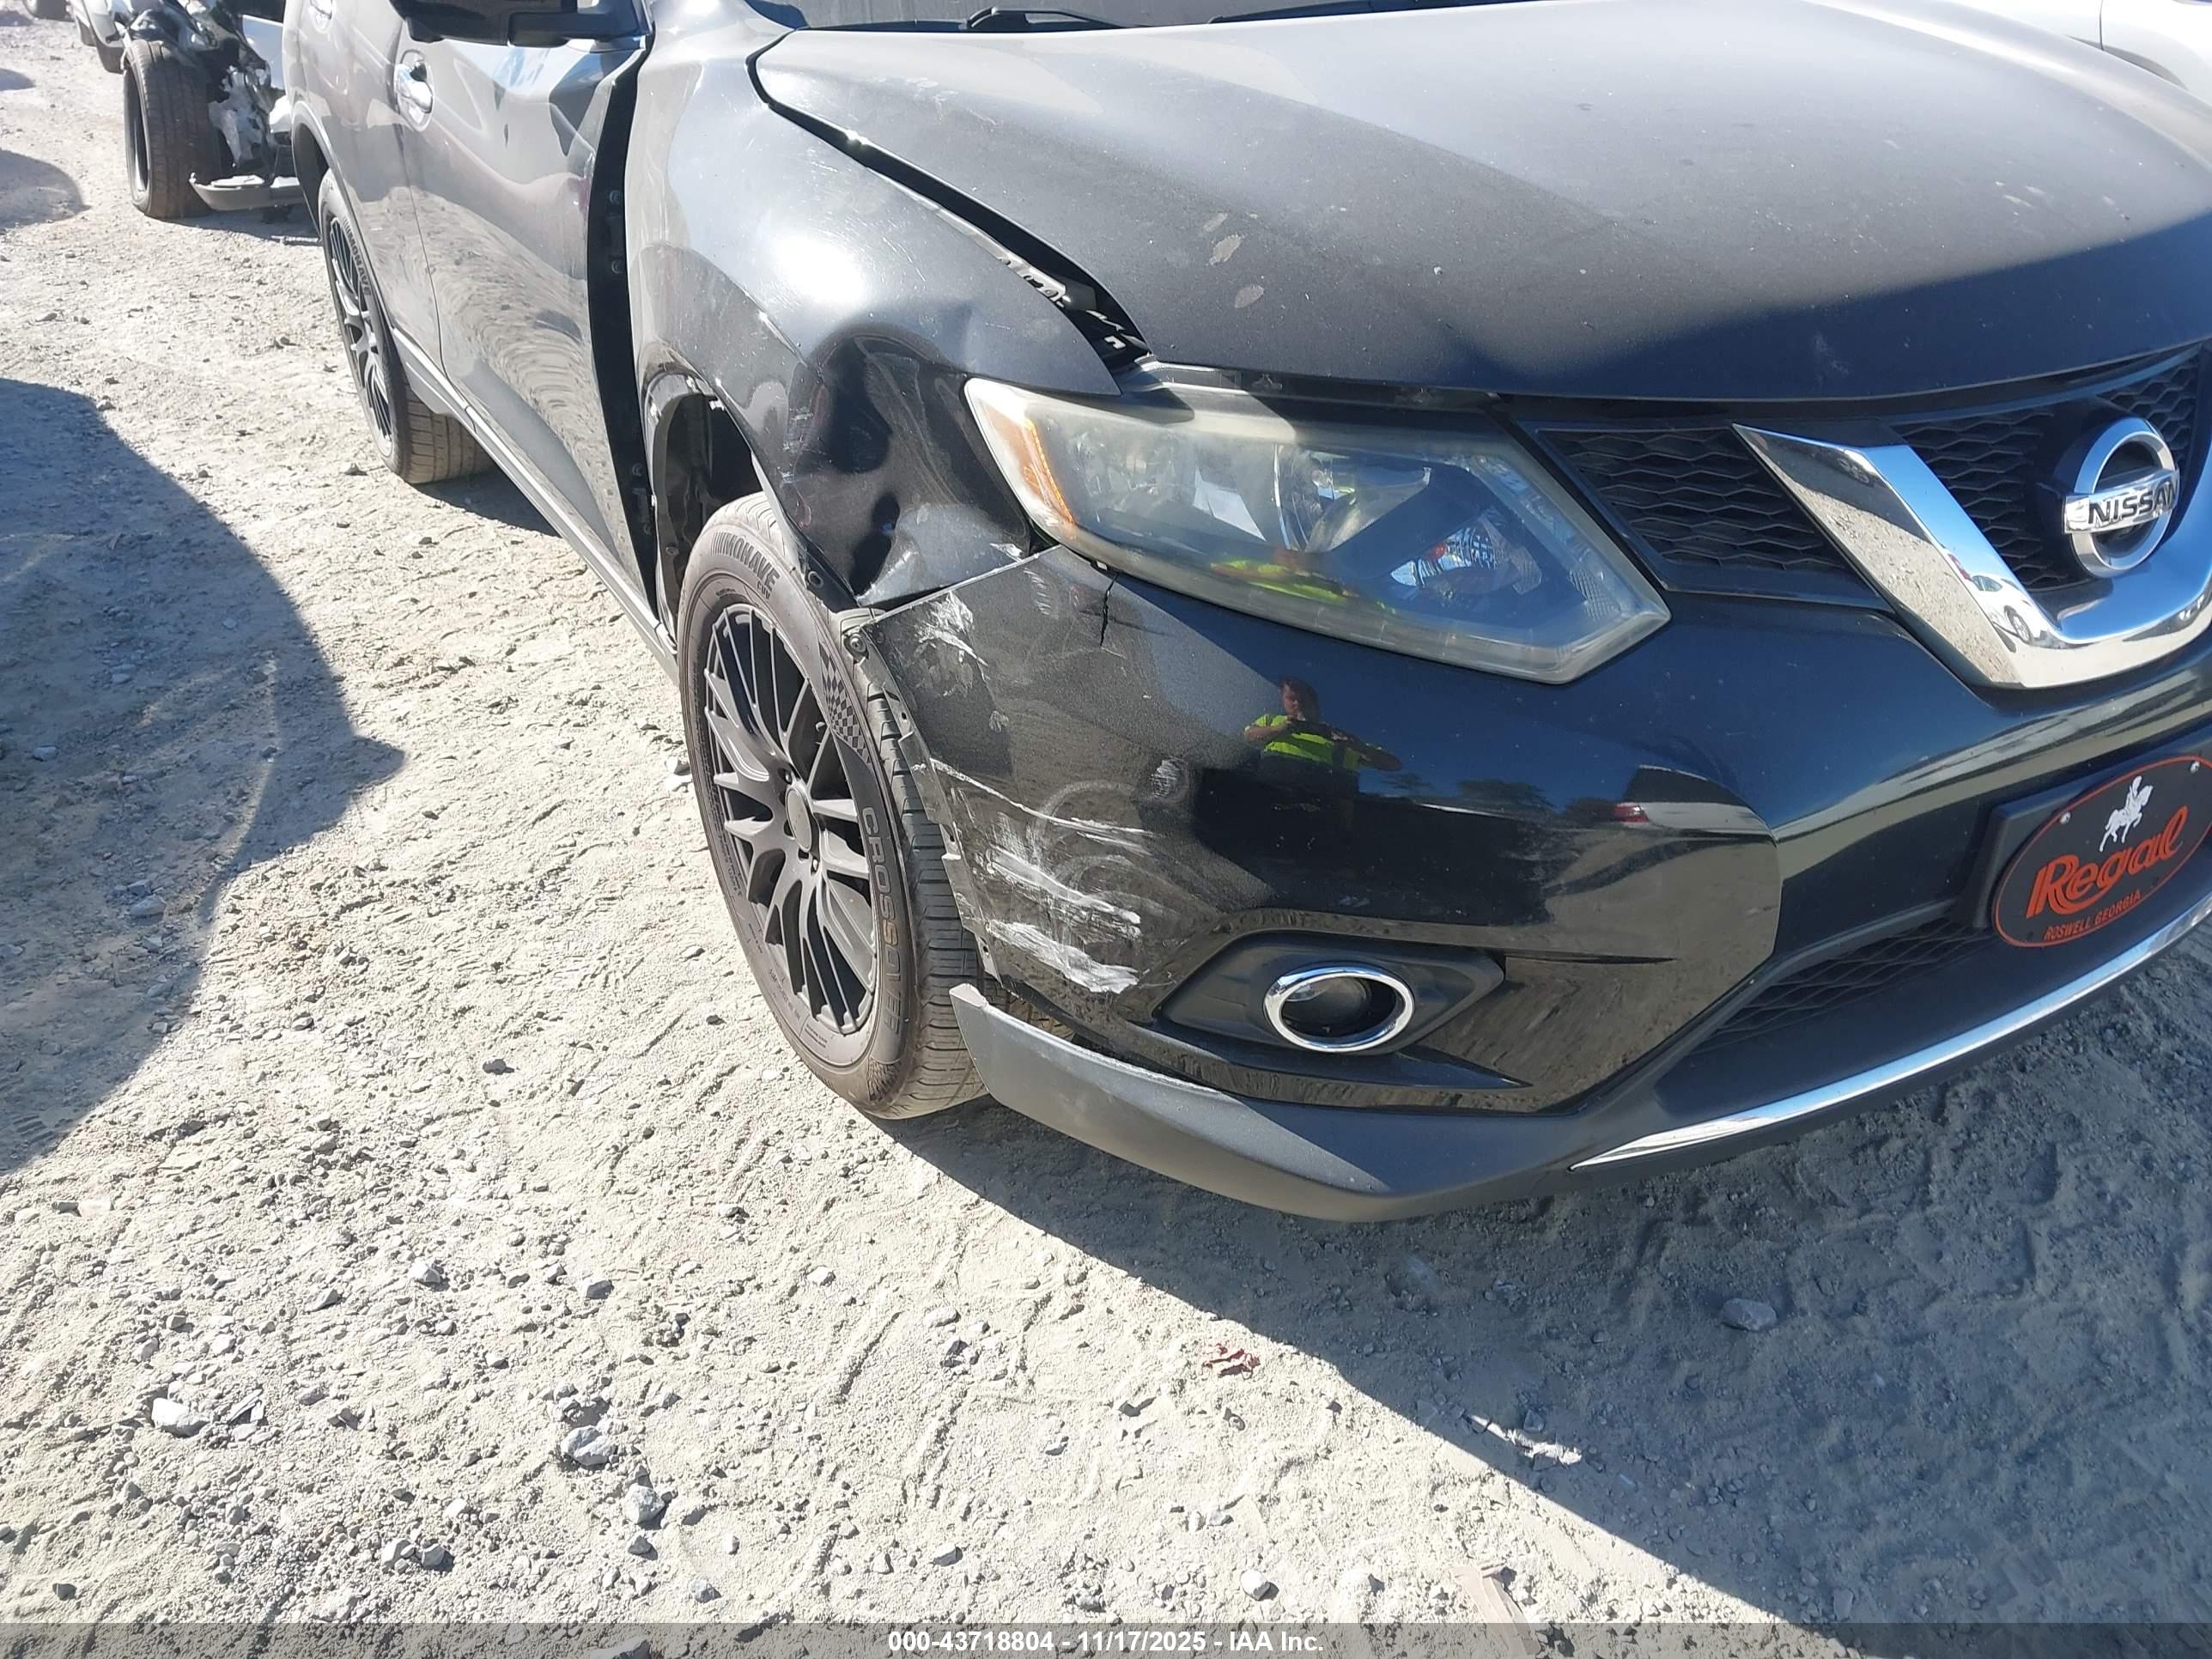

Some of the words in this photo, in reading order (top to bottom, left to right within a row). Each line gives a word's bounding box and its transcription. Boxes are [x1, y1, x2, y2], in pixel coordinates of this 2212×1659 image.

[2087, 480, 2178, 525] NISSAN
[721, 532, 781, 592] MOHAVE
[2026, 805, 2189, 919] Regal
[2044, 916, 2091, 941] ROSWELL
[2094, 889, 2141, 926] GEORGIA
